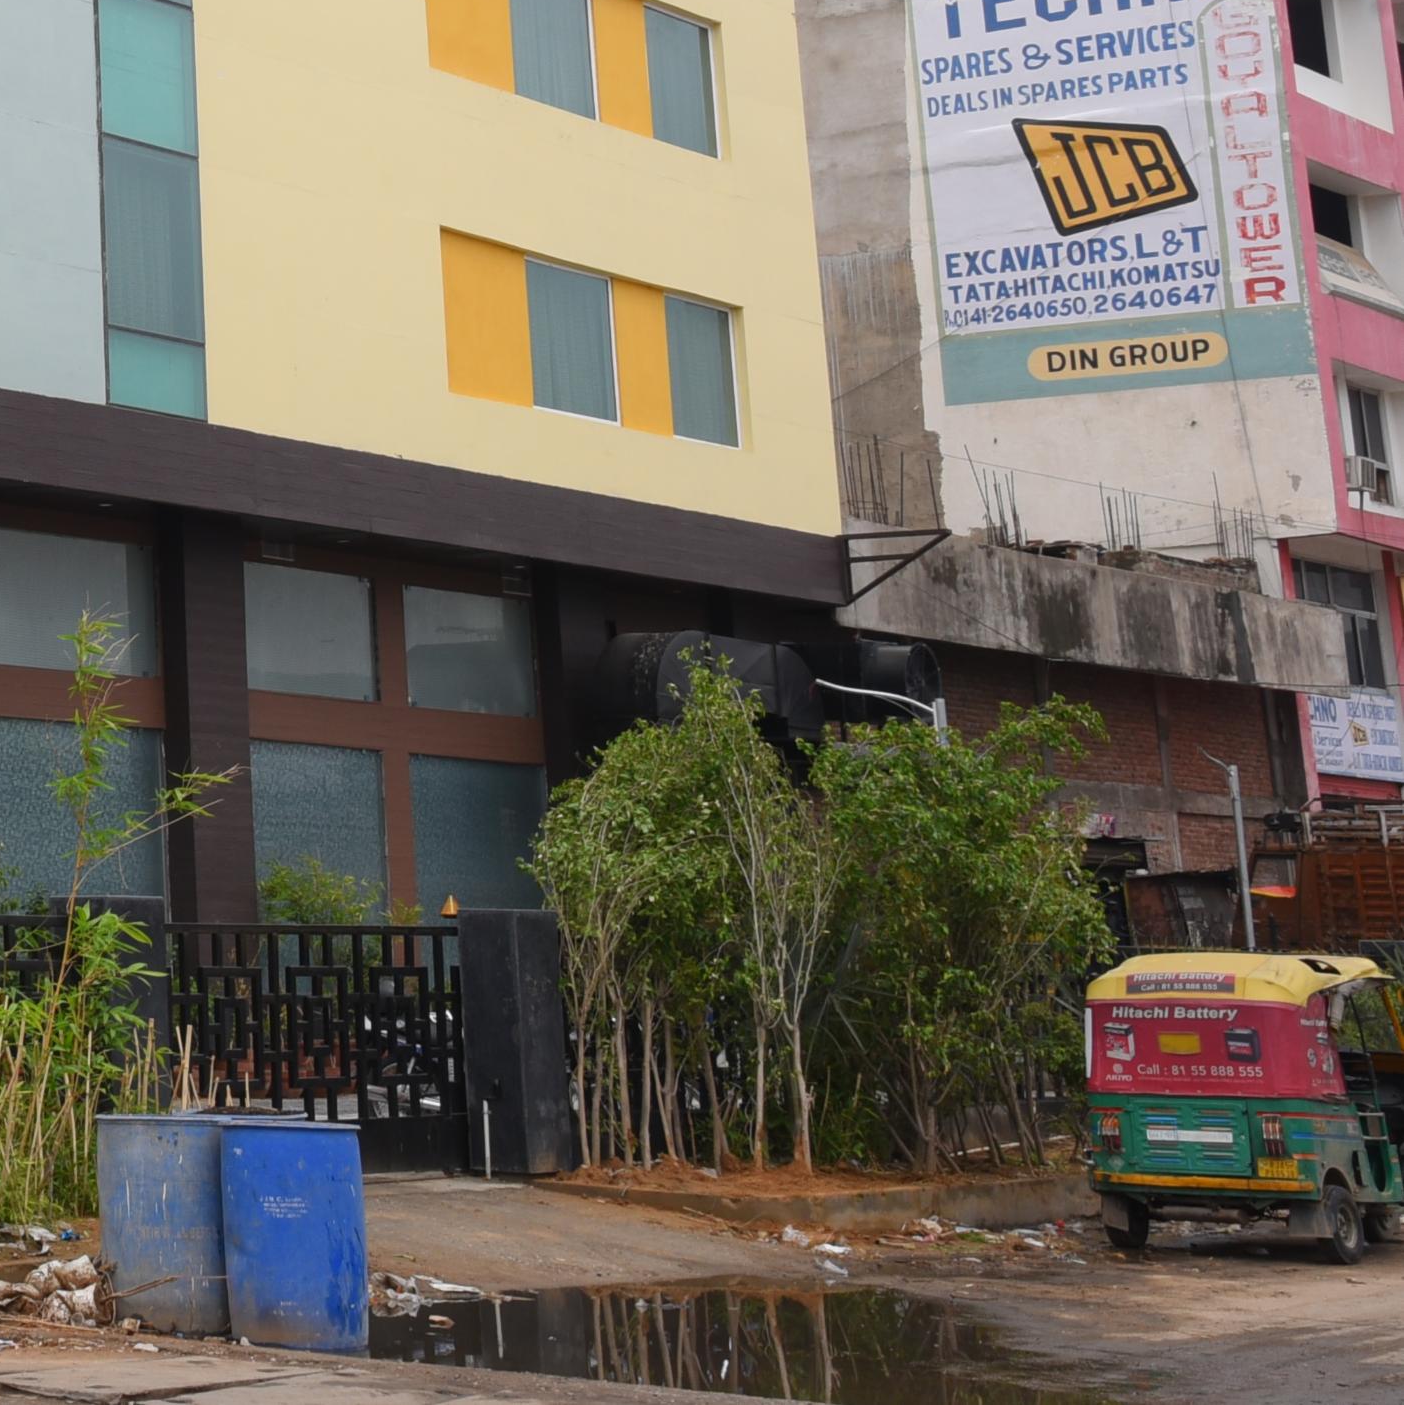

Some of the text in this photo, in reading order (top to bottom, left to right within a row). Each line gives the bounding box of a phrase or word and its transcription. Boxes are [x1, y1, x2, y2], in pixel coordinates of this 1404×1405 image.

[921, 20, 1195, 85] SPARES & SERVICES
[926, 62, 1189, 118] DEALS IN SPARES PARTS
[1049, 131, 1177, 220] JCB
[1093, 282, 1217, 314] 2640647
[1046, 338, 1211, 373] DIN GROUP
[1112, 1006, 1238, 1022] Hitachi Battery
[1137, 1063, 1160, 1075] Call
[1171, 1065, 1186, 1075] 81
[1191, 1065, 1207, 1076] 55
[1210, 1065, 1235, 1077] 888
[1238, 1066, 1264, 1078] 555
